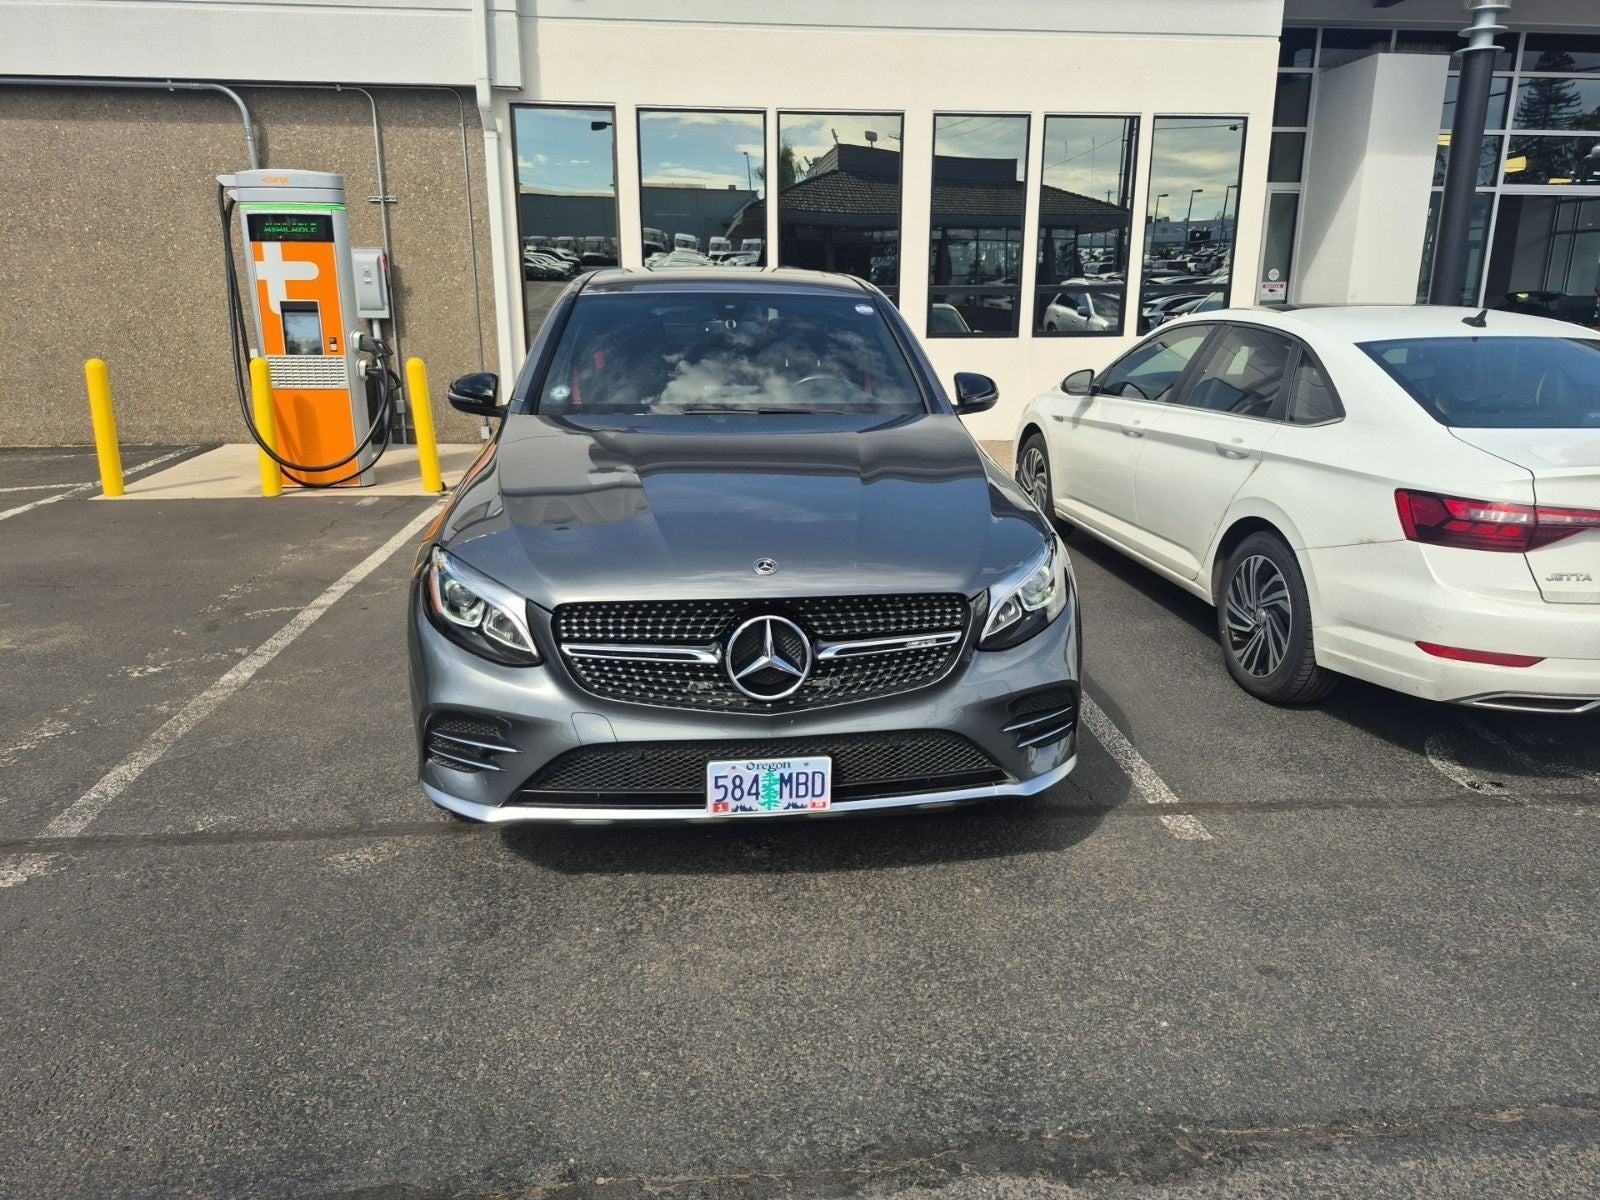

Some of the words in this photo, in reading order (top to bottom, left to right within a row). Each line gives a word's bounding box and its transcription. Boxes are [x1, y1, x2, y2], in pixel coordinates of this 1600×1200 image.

[1546, 572, 1593, 581] JETTA
[746, 762, 791, 772] Oregon
[714, 774, 760, 802] 584
[780, 771, 825, 799] MBD
